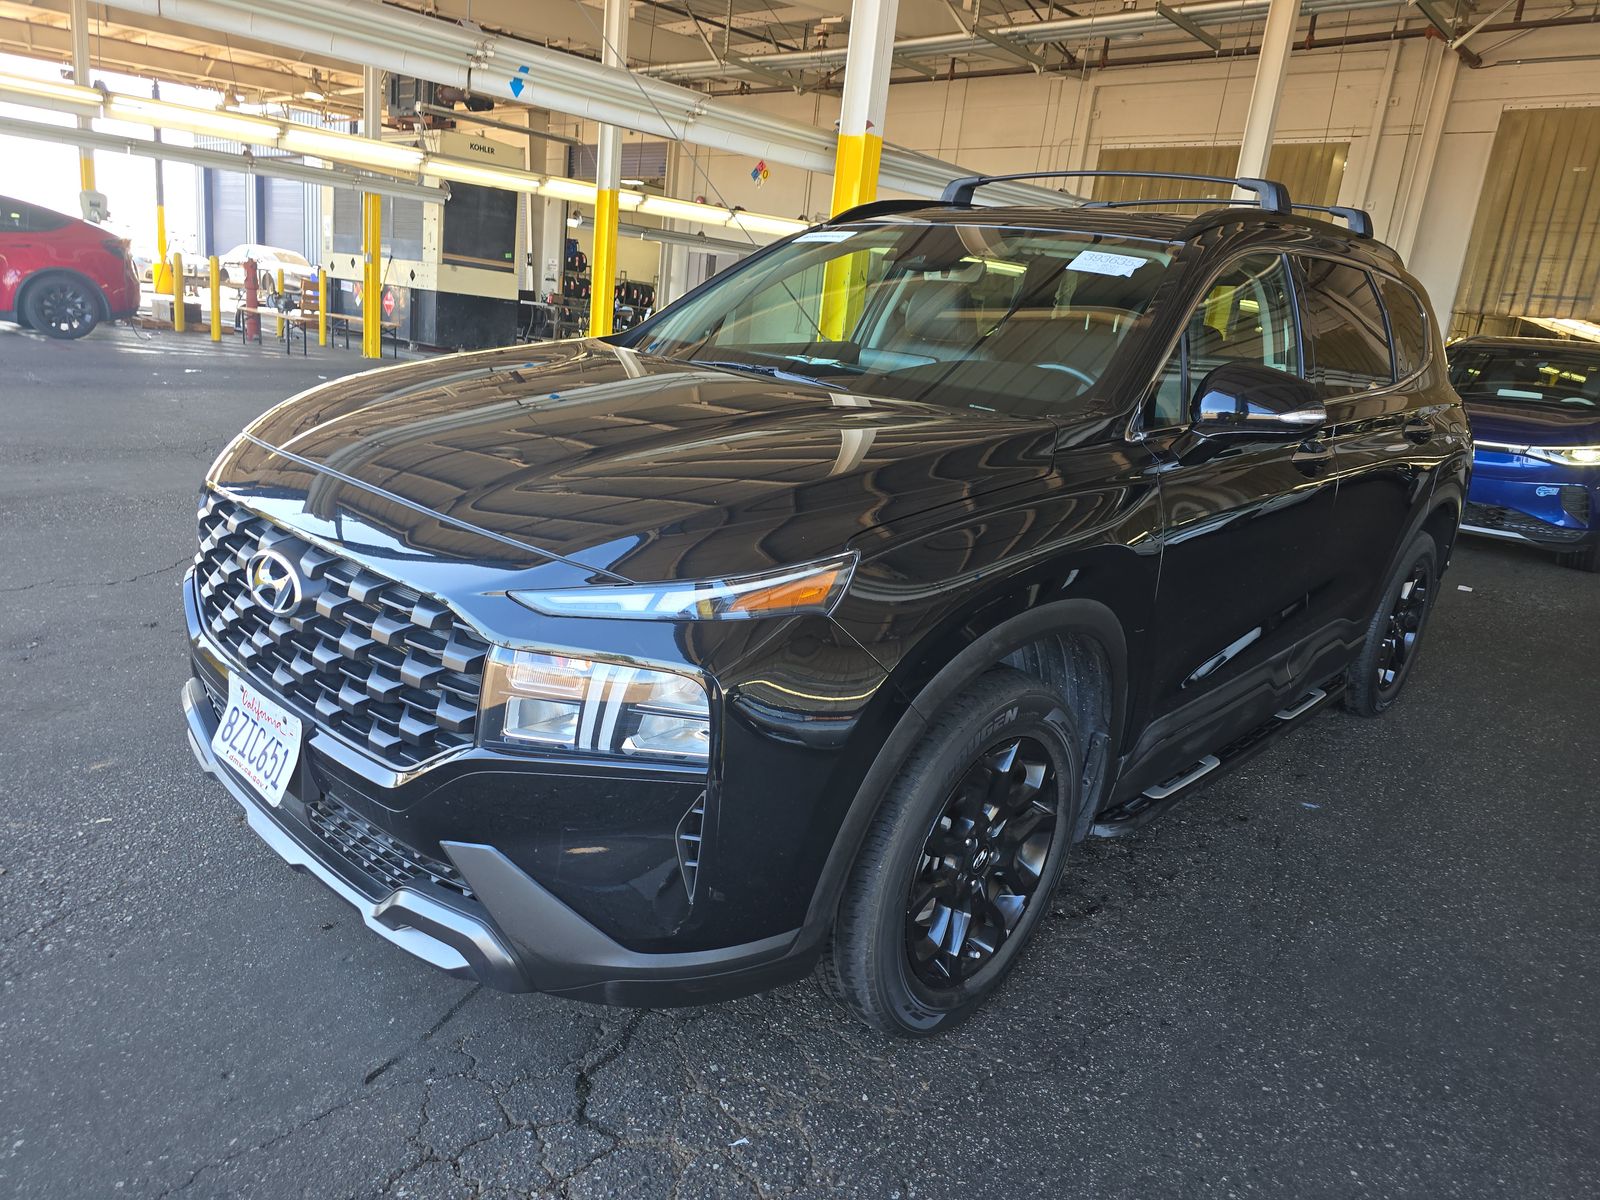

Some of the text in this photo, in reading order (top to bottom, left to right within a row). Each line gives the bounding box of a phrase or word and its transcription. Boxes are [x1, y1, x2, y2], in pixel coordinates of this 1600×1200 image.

[469, 142, 495, 155] KOHLER
[242, 689, 286, 736] California
[221, 705, 289, 790] 8ZIC651
[228, 754, 264, 788] dmv.ca.gov
